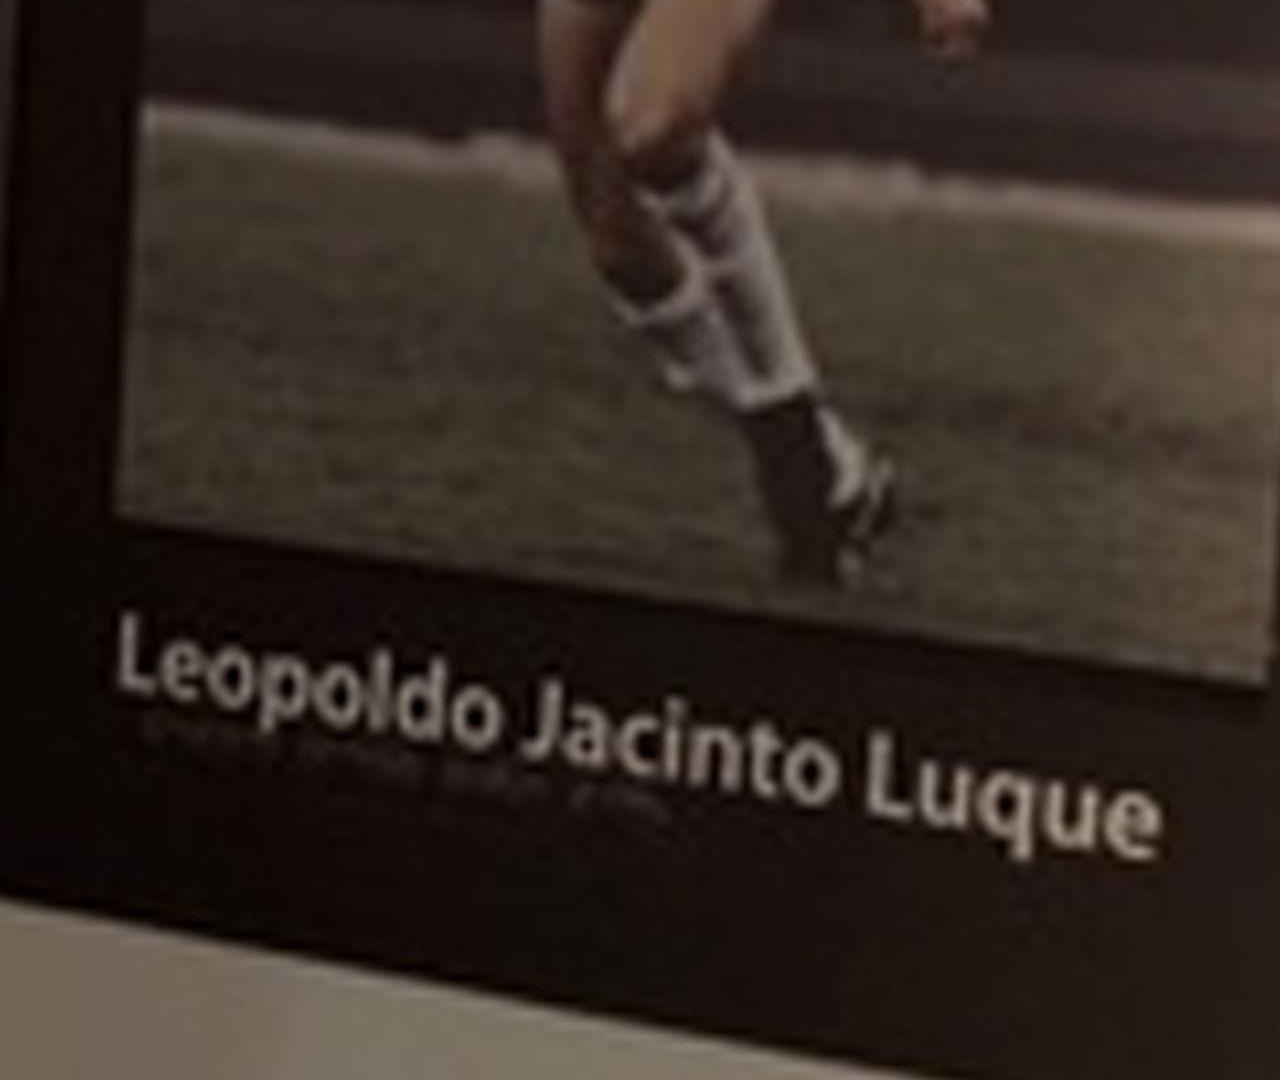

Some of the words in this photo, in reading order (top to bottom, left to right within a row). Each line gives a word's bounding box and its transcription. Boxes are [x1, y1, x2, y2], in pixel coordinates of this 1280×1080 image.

[119, 614, 503, 751] Leopoldo
[521, 680, 841, 807] Jacinto
[864, 731, 1164, 863] Luque
